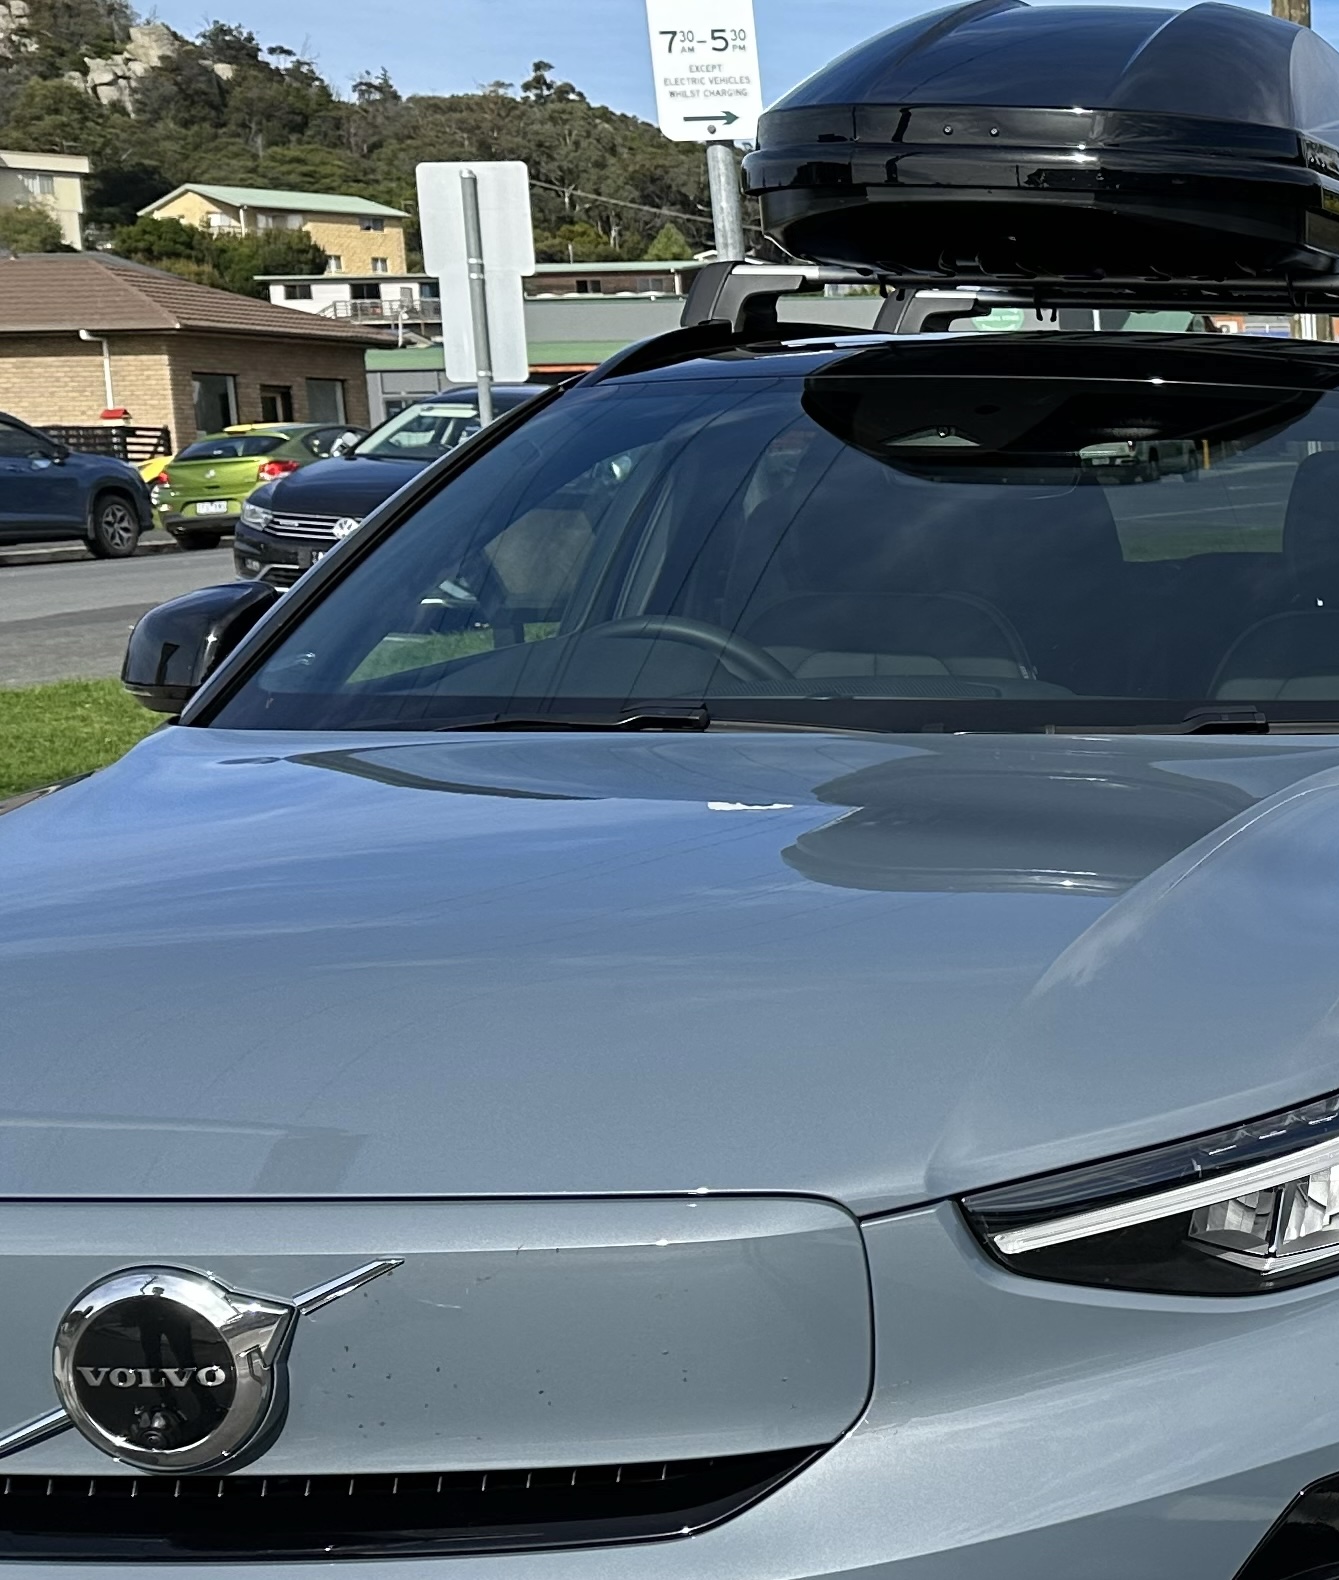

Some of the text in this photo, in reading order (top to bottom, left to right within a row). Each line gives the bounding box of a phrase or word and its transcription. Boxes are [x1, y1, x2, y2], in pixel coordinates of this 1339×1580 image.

[689, 64, 722, 73] EXCEPT
[664, 76, 750, 86] ELECTRIC VEHICLES
[669, 88, 748, 98] WHILST CHARGING
[76, 1365, 226, 1388] VOLVO
